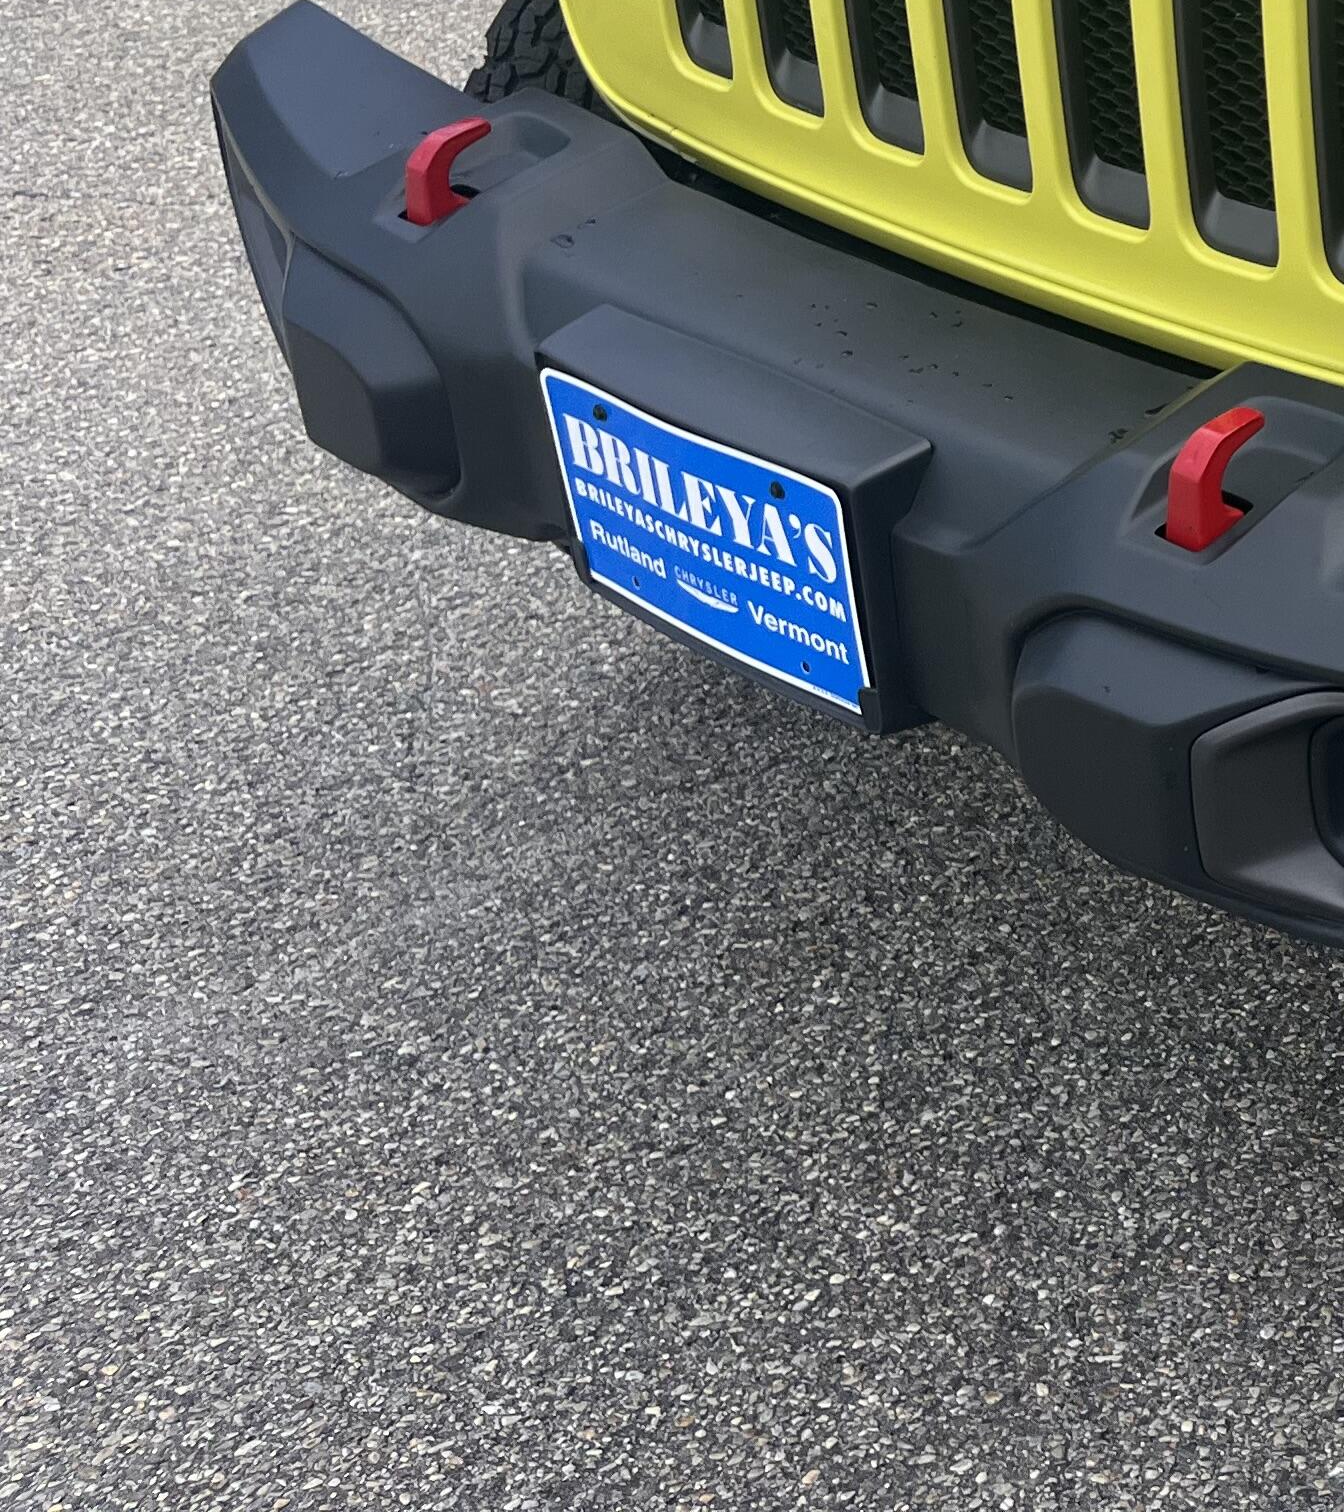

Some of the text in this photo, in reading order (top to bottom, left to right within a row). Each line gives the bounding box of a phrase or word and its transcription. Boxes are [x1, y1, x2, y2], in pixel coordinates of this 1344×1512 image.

[563, 413, 837, 584] BRILEYA'S
[574, 476, 847, 623] BRILEYASCHRYSLERJEEP.COM
[589, 519, 850, 665] Rutland CHRYSLER Vermont
